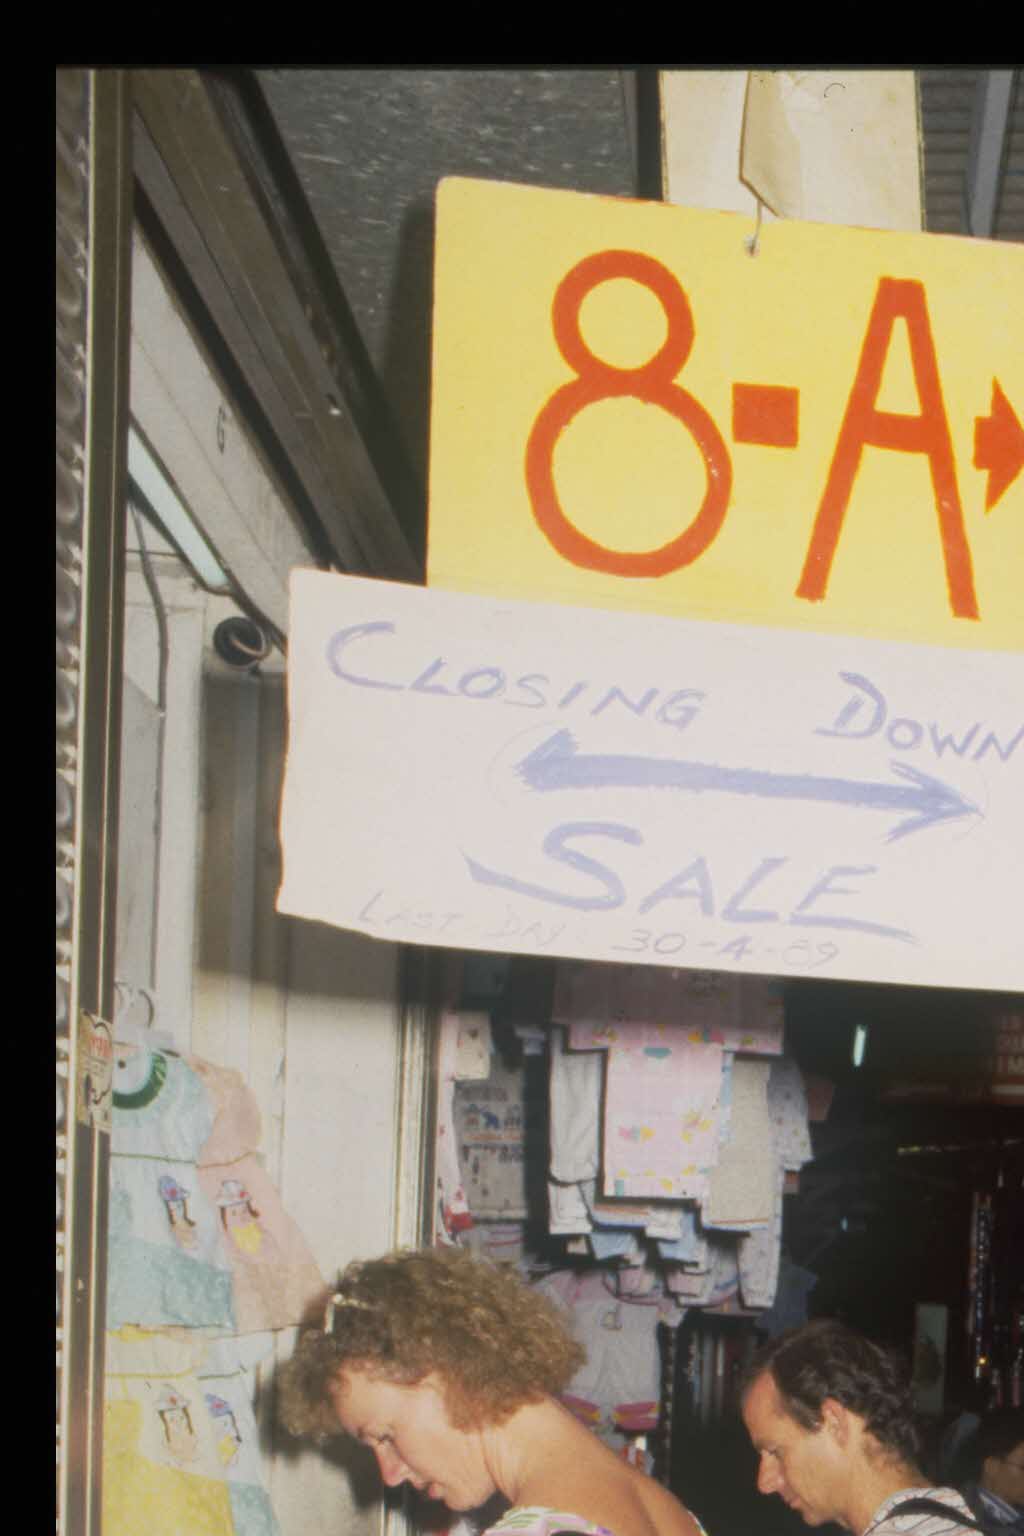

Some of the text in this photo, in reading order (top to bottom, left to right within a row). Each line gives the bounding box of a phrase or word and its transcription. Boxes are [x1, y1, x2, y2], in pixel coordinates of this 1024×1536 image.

[525, 248, 980, 621] 8-A
[326, 621, 706, 730] CLOSING
[459, 821, 915, 944] SALE
